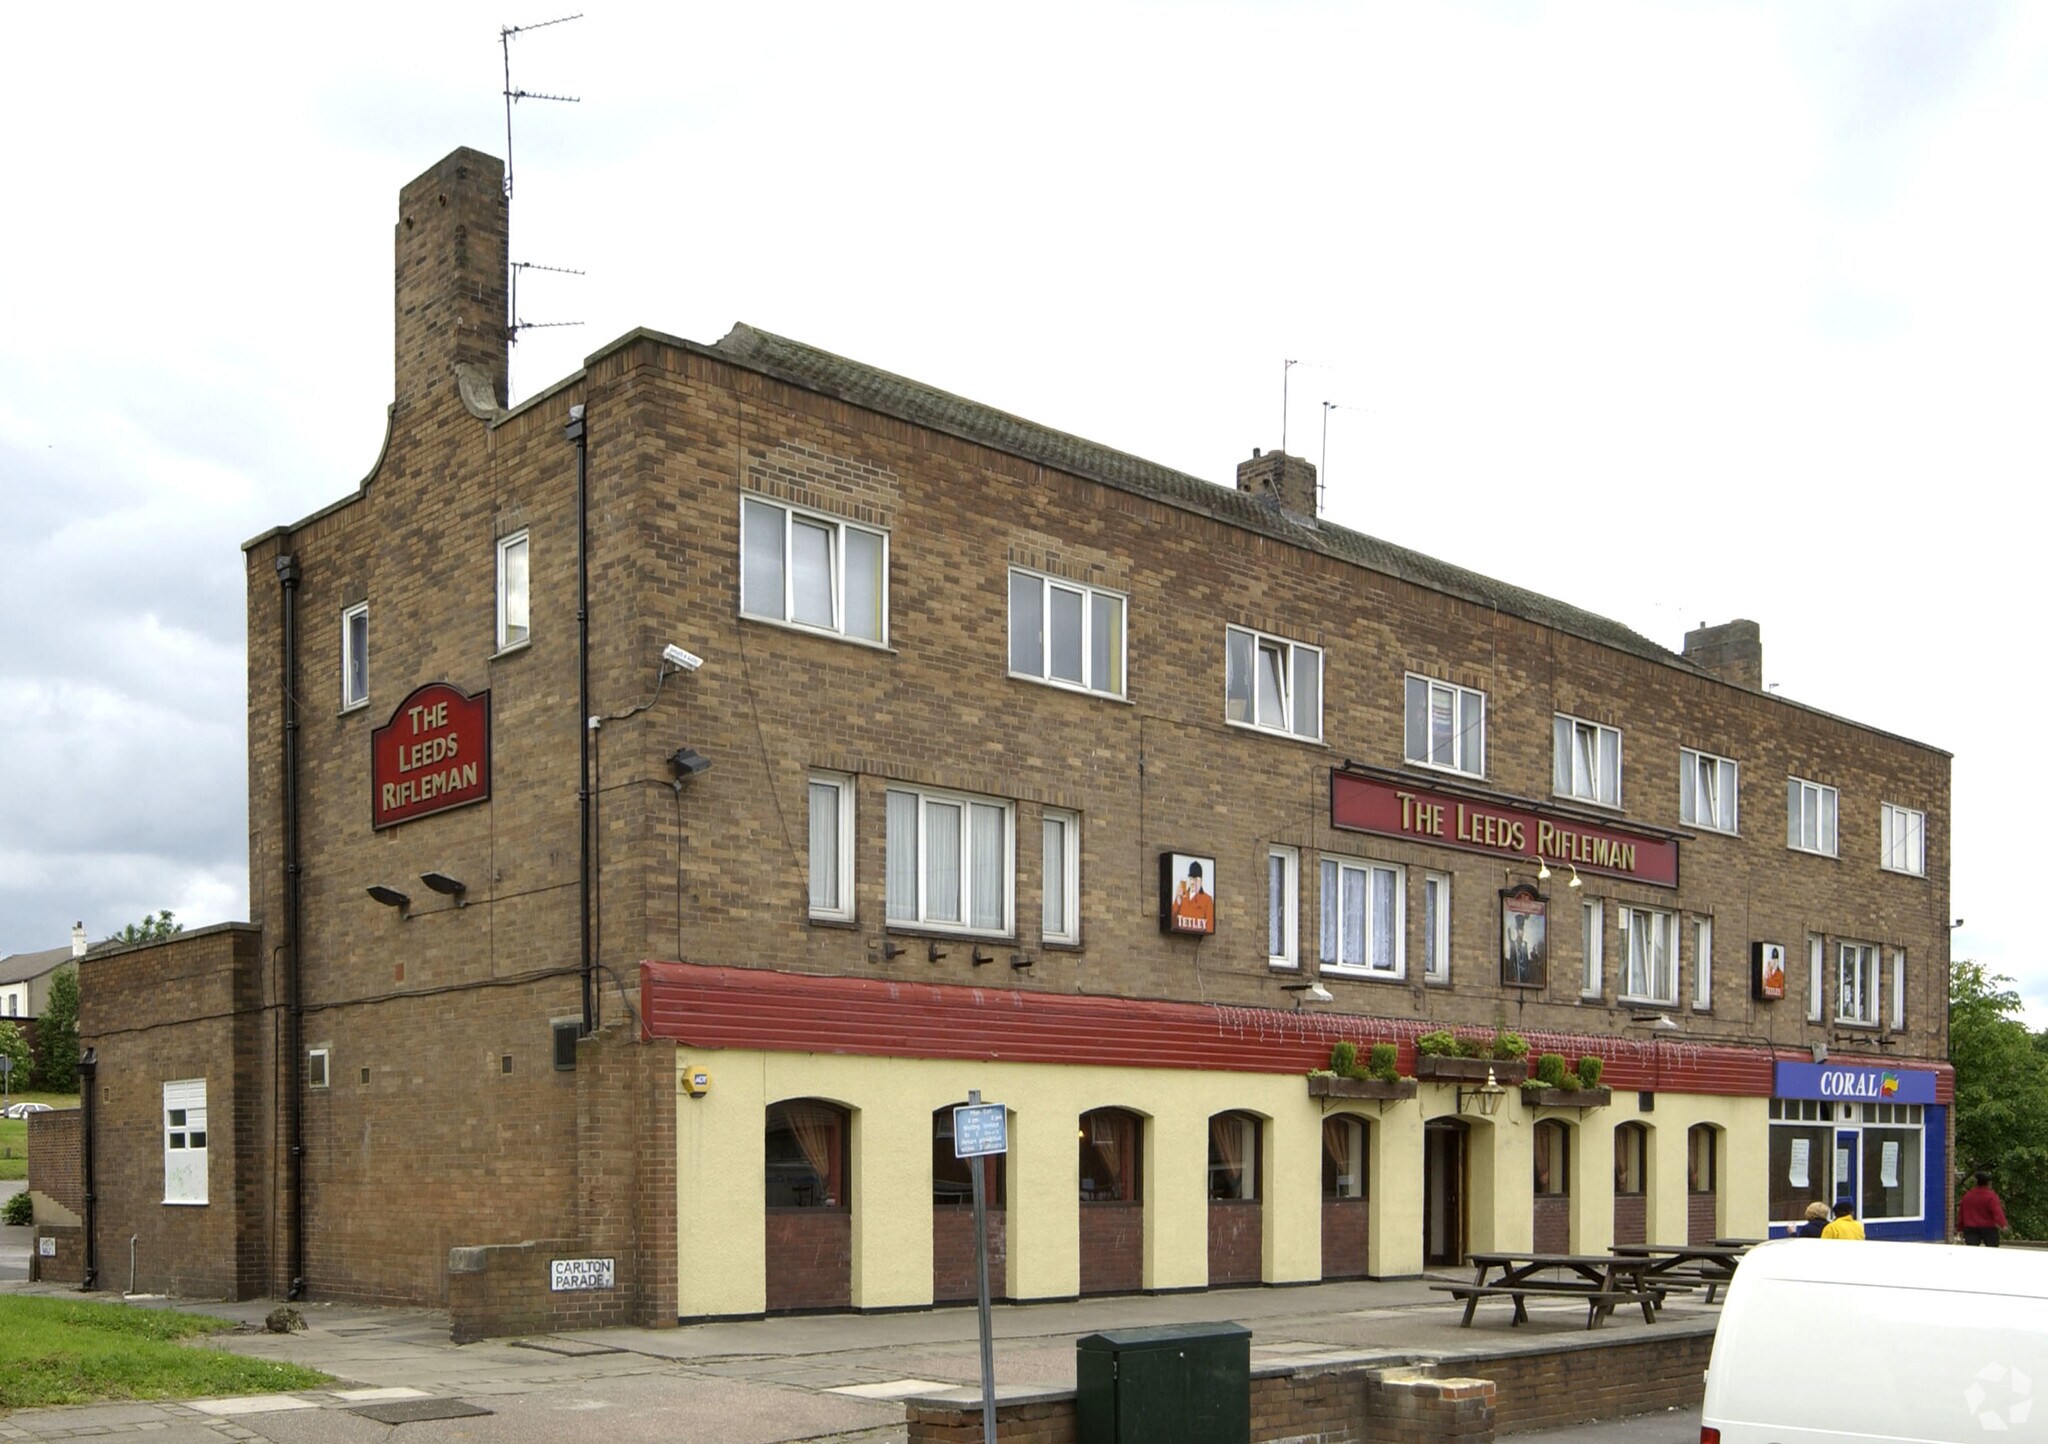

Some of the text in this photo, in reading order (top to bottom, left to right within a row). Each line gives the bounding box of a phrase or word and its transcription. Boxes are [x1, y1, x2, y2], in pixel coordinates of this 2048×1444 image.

[408, 701, 449, 736] THE
[399, 732, 459, 773] LEEDS
[382, 761, 478, 812] RIFLEMAN
[1396, 790, 1637, 872] THE LEEDS RIFLEMAN
[1177, 914, 1208, 930] TETLEY
[1820, 1071, 1878, 1097] CORAL
[555, 1260, 611, 1275] CARLTON
[555, 1274, 604, 1288] PARADE
